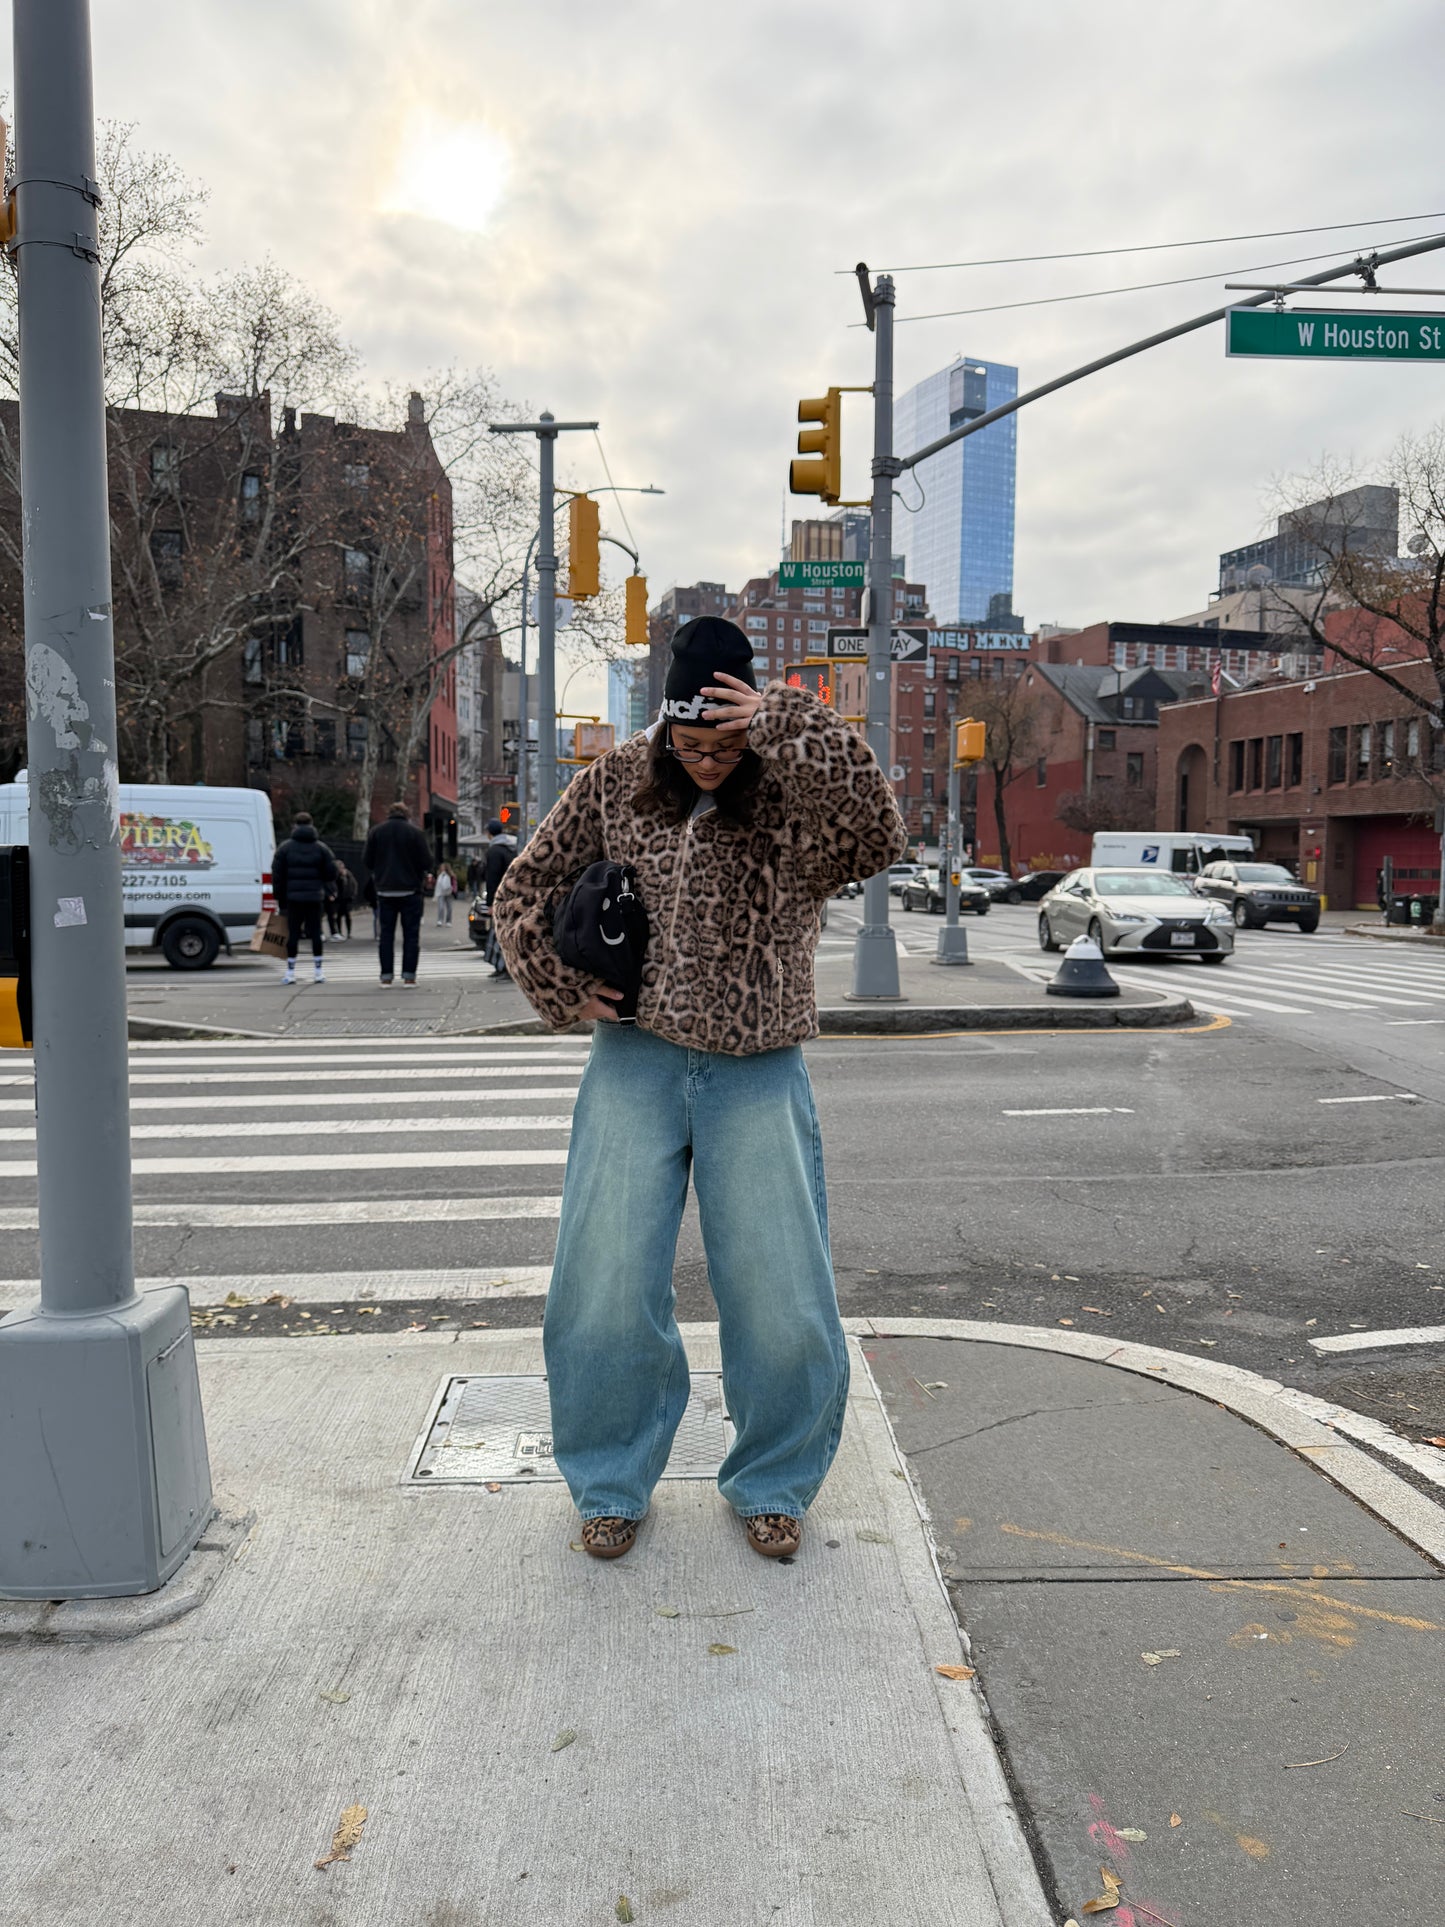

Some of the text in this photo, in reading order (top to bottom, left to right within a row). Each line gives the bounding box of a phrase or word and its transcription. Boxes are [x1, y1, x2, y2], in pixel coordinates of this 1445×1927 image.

[1298, 322, 1441, 350] W Houston St
[782, 563, 863, 578] W Houston
[811, 578, 834, 586] Street
[837, 638, 912, 651] ONE AY
[975, 632, 1033, 650] MINT
